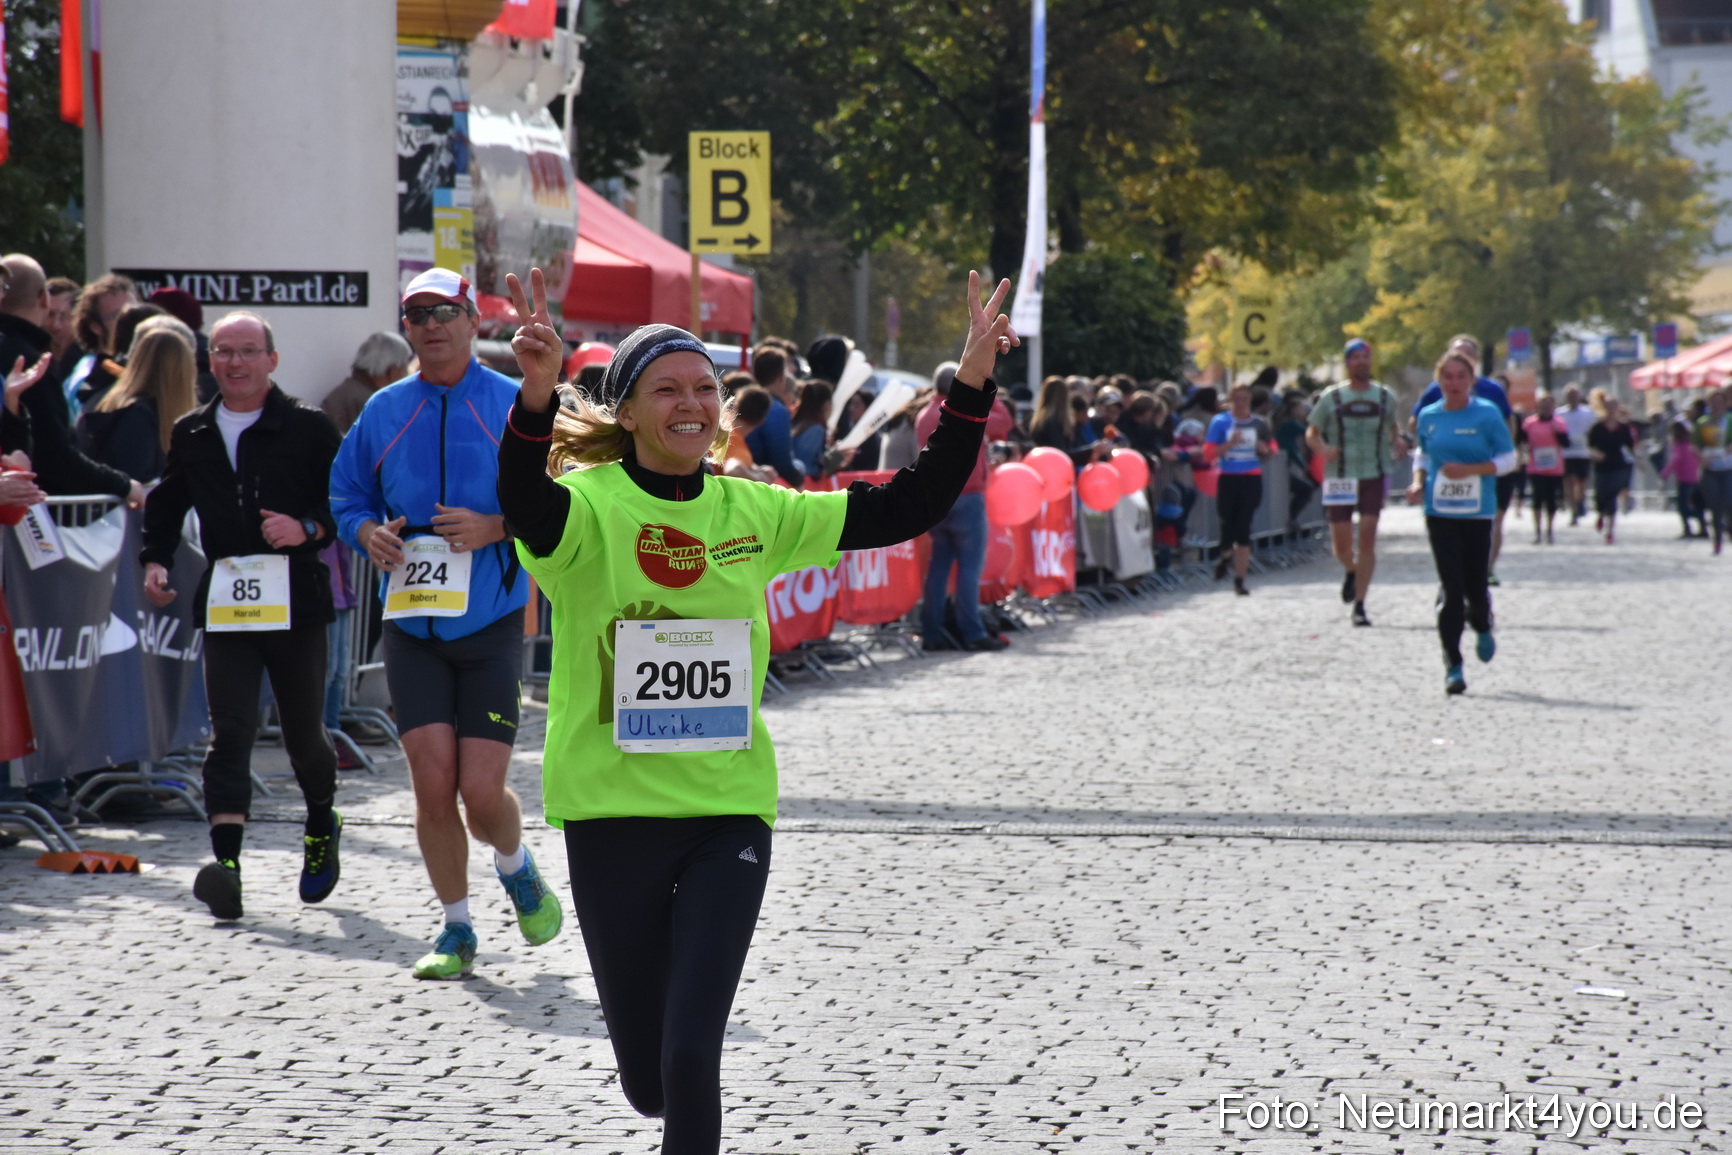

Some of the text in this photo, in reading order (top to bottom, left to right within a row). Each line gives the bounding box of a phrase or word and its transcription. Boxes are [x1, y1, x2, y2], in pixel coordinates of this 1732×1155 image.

[699, 137, 761, 159] Block
[711, 169, 751, 227] B
[1243, 312, 1266, 346] C
[1440, 482, 1472, 497] 2367
[403, 560, 449, 587] 224
[232, 578, 261, 602] 85
[410, 593, 438, 604] Robert
[233, 609, 261, 618] Harald
[668, 631, 714, 643] BOCK
[636, 660, 732, 700] 2905
[622, 695, 628, 704] D
